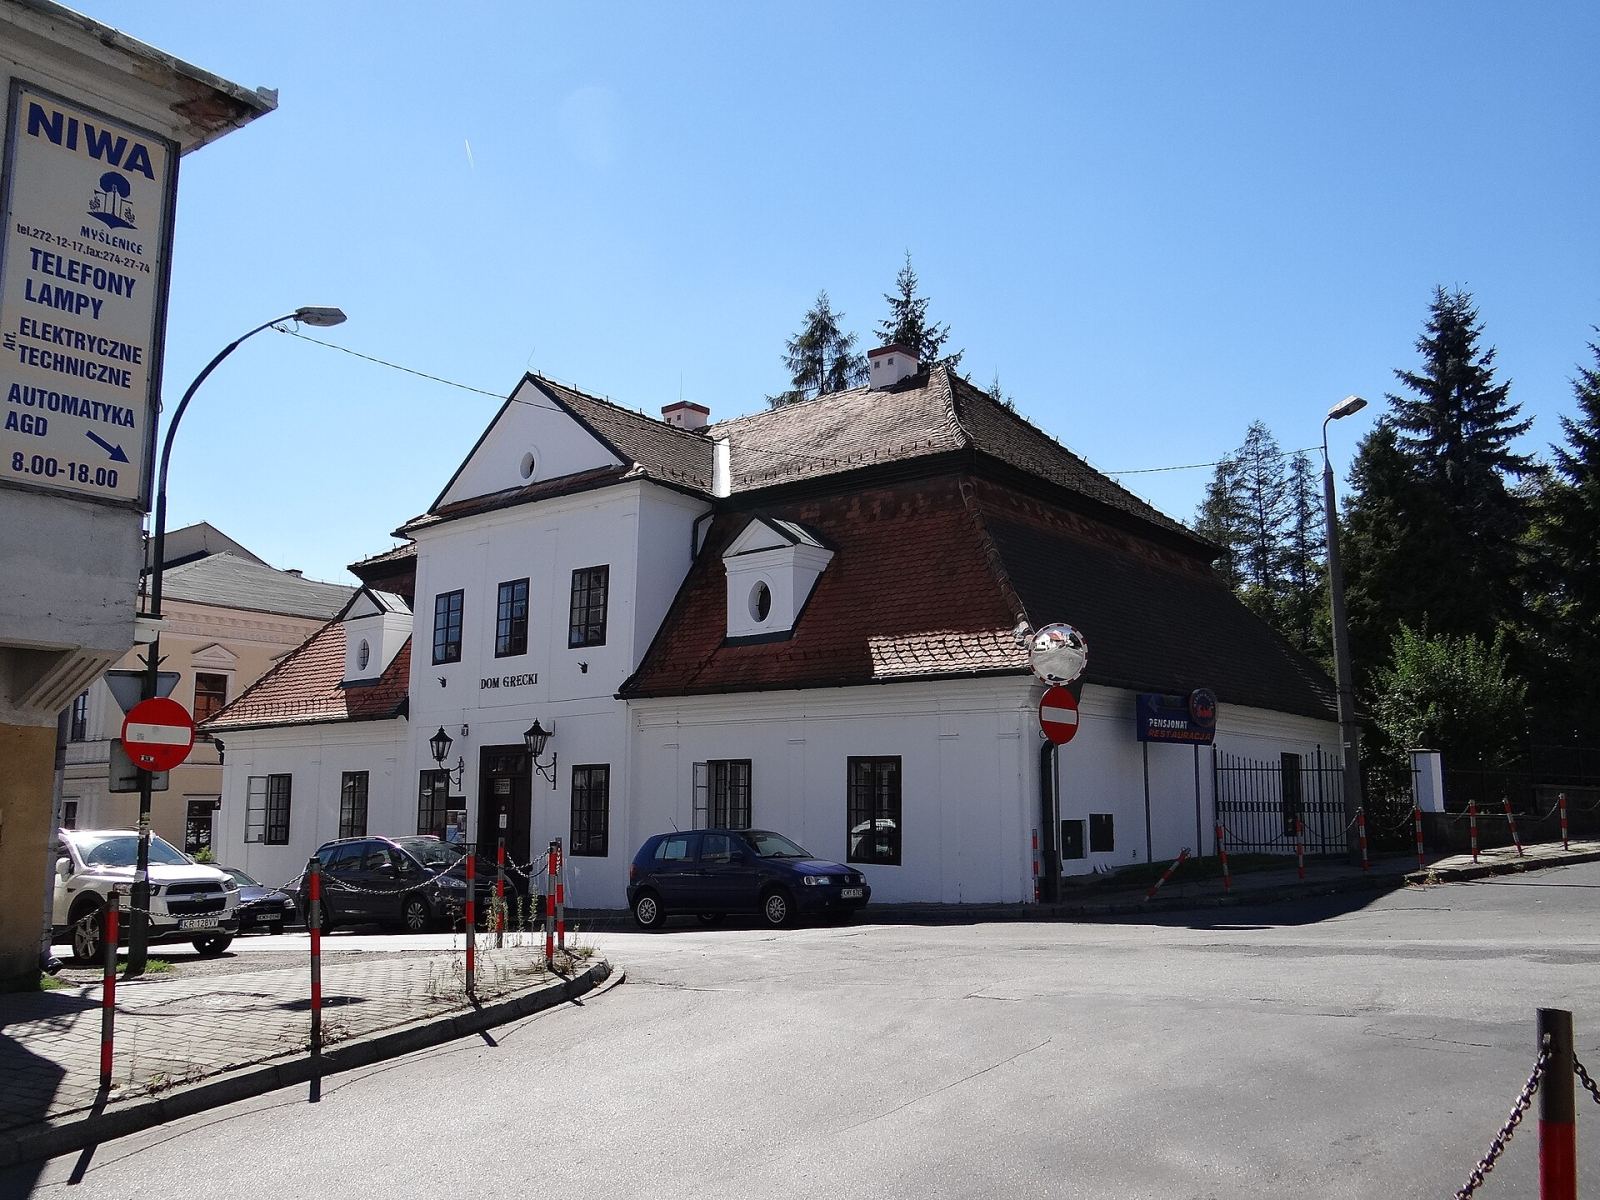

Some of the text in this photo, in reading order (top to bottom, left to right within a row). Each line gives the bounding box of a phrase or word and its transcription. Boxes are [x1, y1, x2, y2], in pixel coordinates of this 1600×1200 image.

[27, 101, 156, 181] NIWA
[80, 225, 144, 256] MYŚLENICE
[30, 247, 137, 299] TELEFONY
[25, 278, 104, 320] LAMPY
[3, 331, 17, 352] Art.
[19, 316, 143, 366] ELEKTRYCZNE
[18, 344, 132, 389] TECHNICZNE
[4, 410, 49, 437] AGD
[7, 382, 136, 429] AUTOMATYKA
[11, 451, 119, 489] 8.00-18.00
[480, 673, 538, 690] DOM GRECKI
[1148, 717, 1188, 730] PENSJONAT
